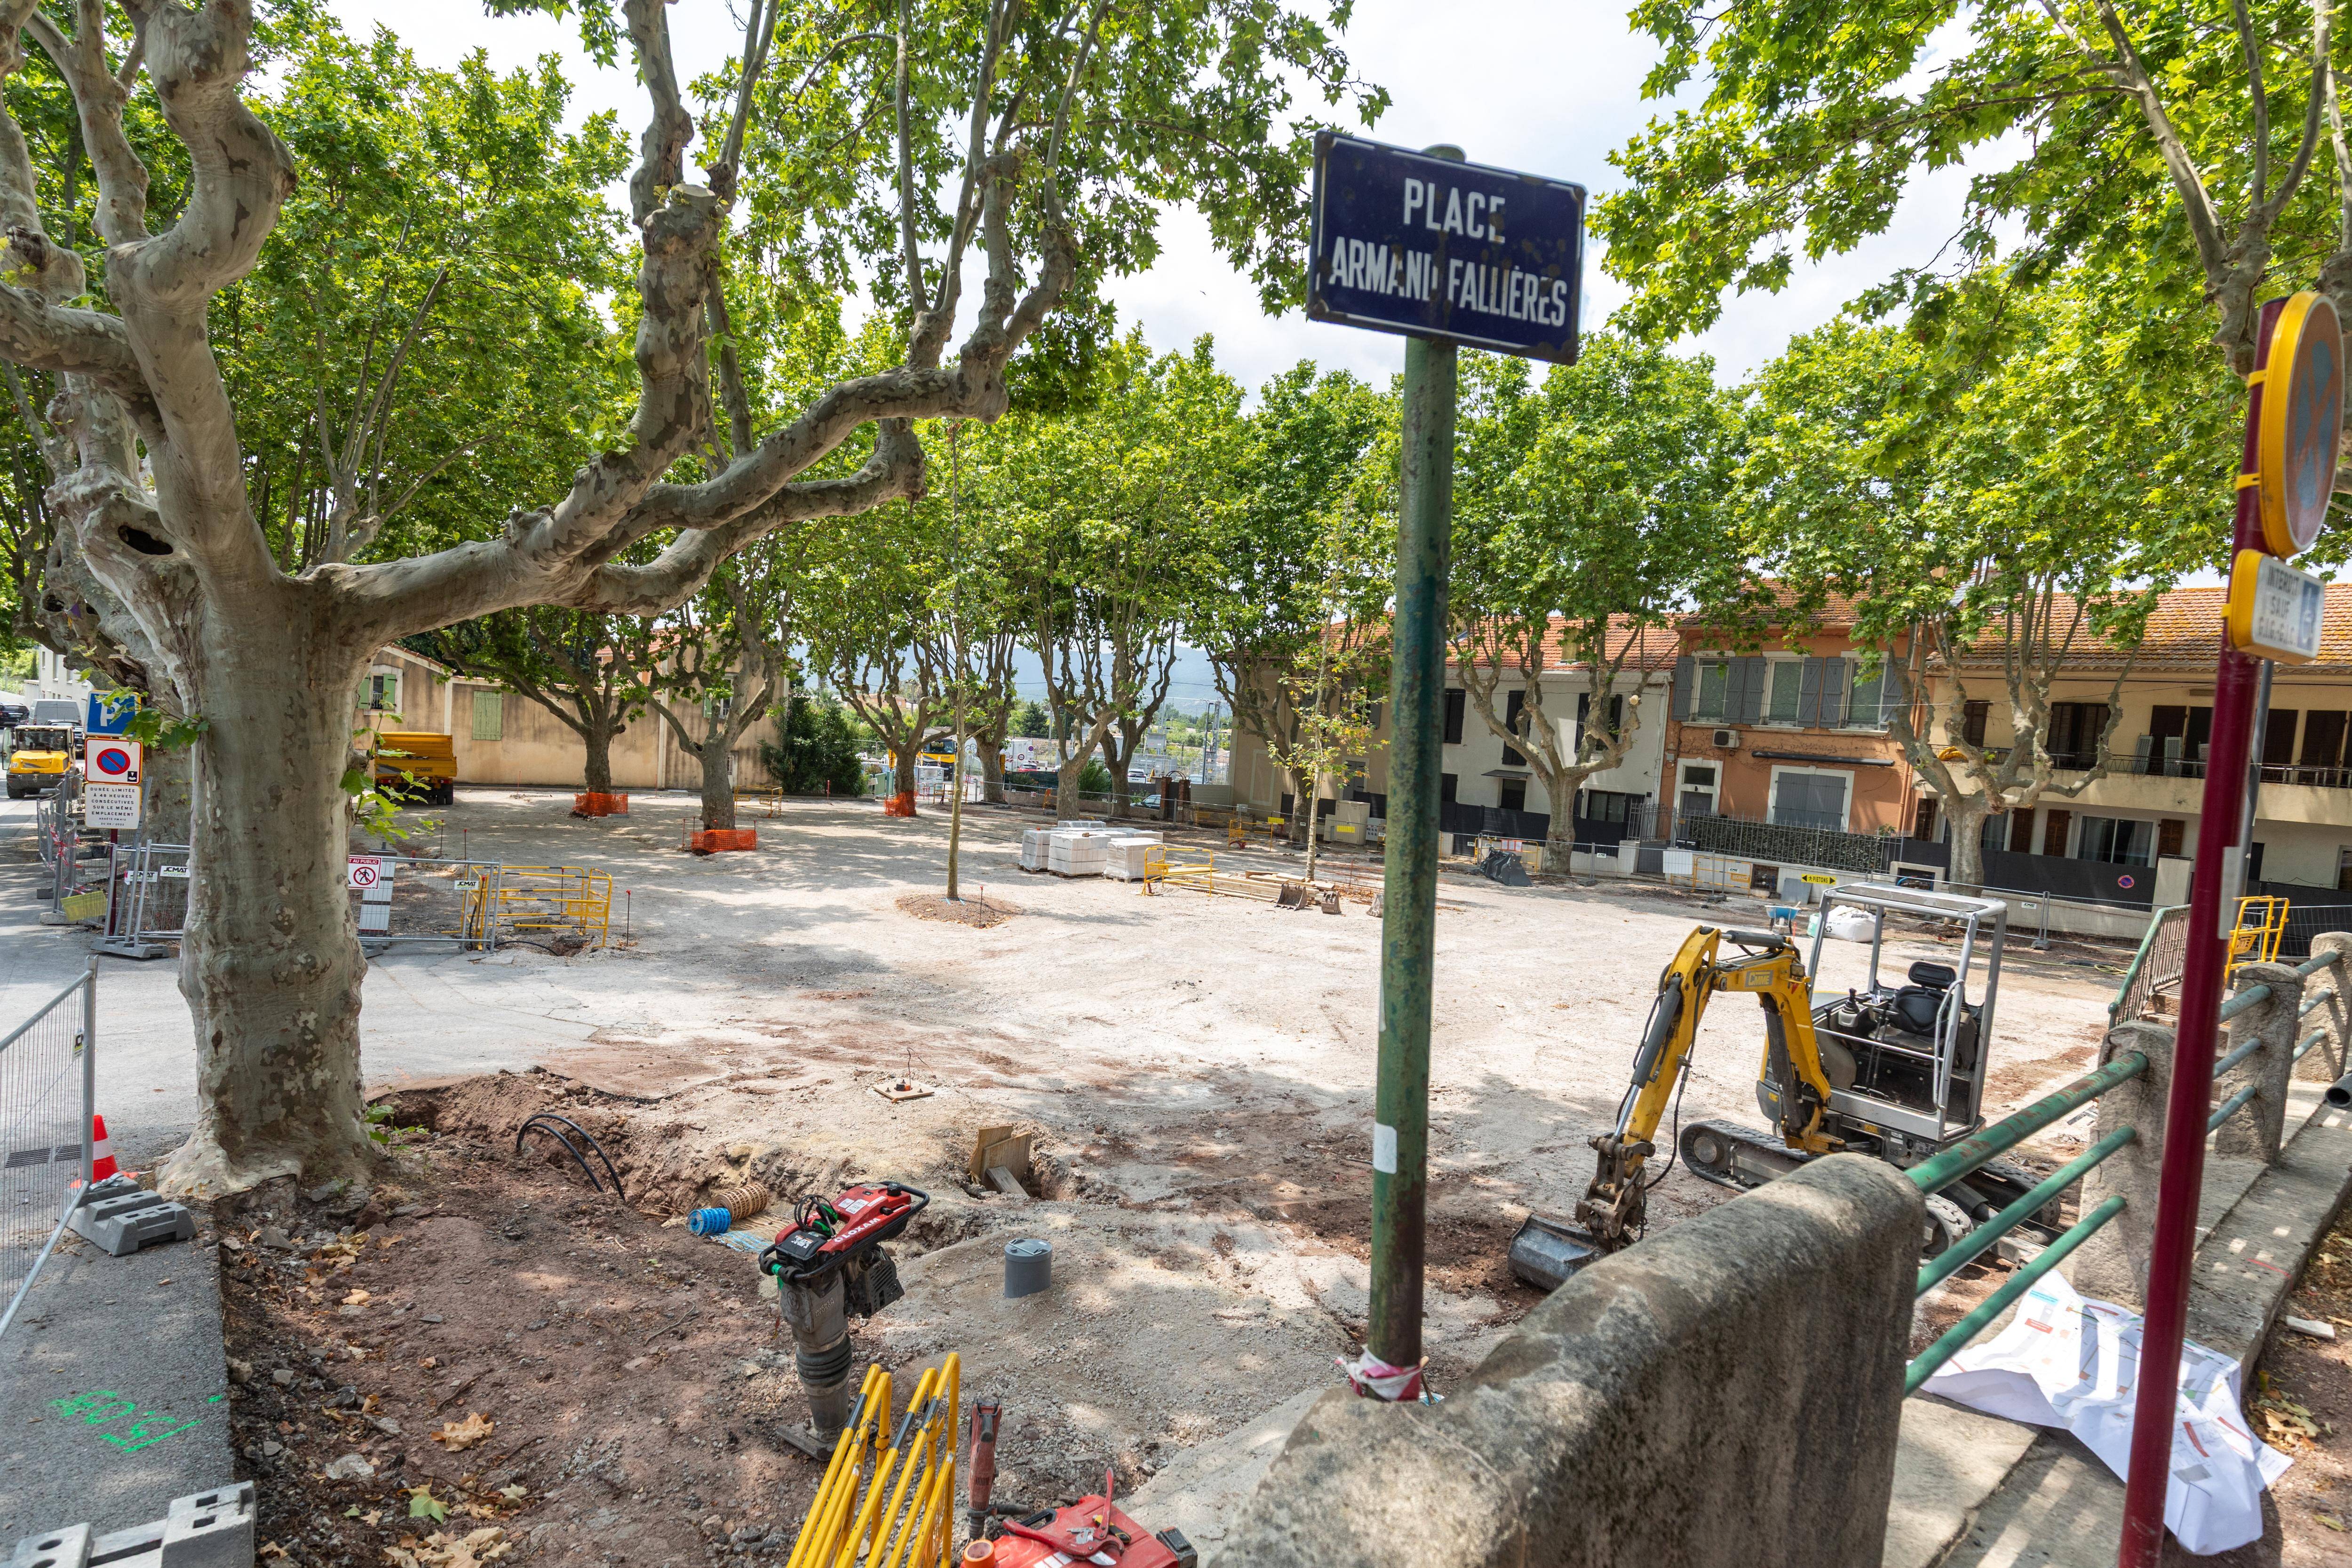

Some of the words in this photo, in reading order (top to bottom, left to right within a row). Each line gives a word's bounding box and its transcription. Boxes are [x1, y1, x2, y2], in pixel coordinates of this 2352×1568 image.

[1403, 178, 1505, 243] PLACE
[2267, 565, 2299, 597] INTERDIT
[2271, 596, 2291, 619] SAUF
[100, 700, 119, 726] P
[842, 1218, 881, 1239] LOXAM
[815, 1297, 834, 1314] WACKER
